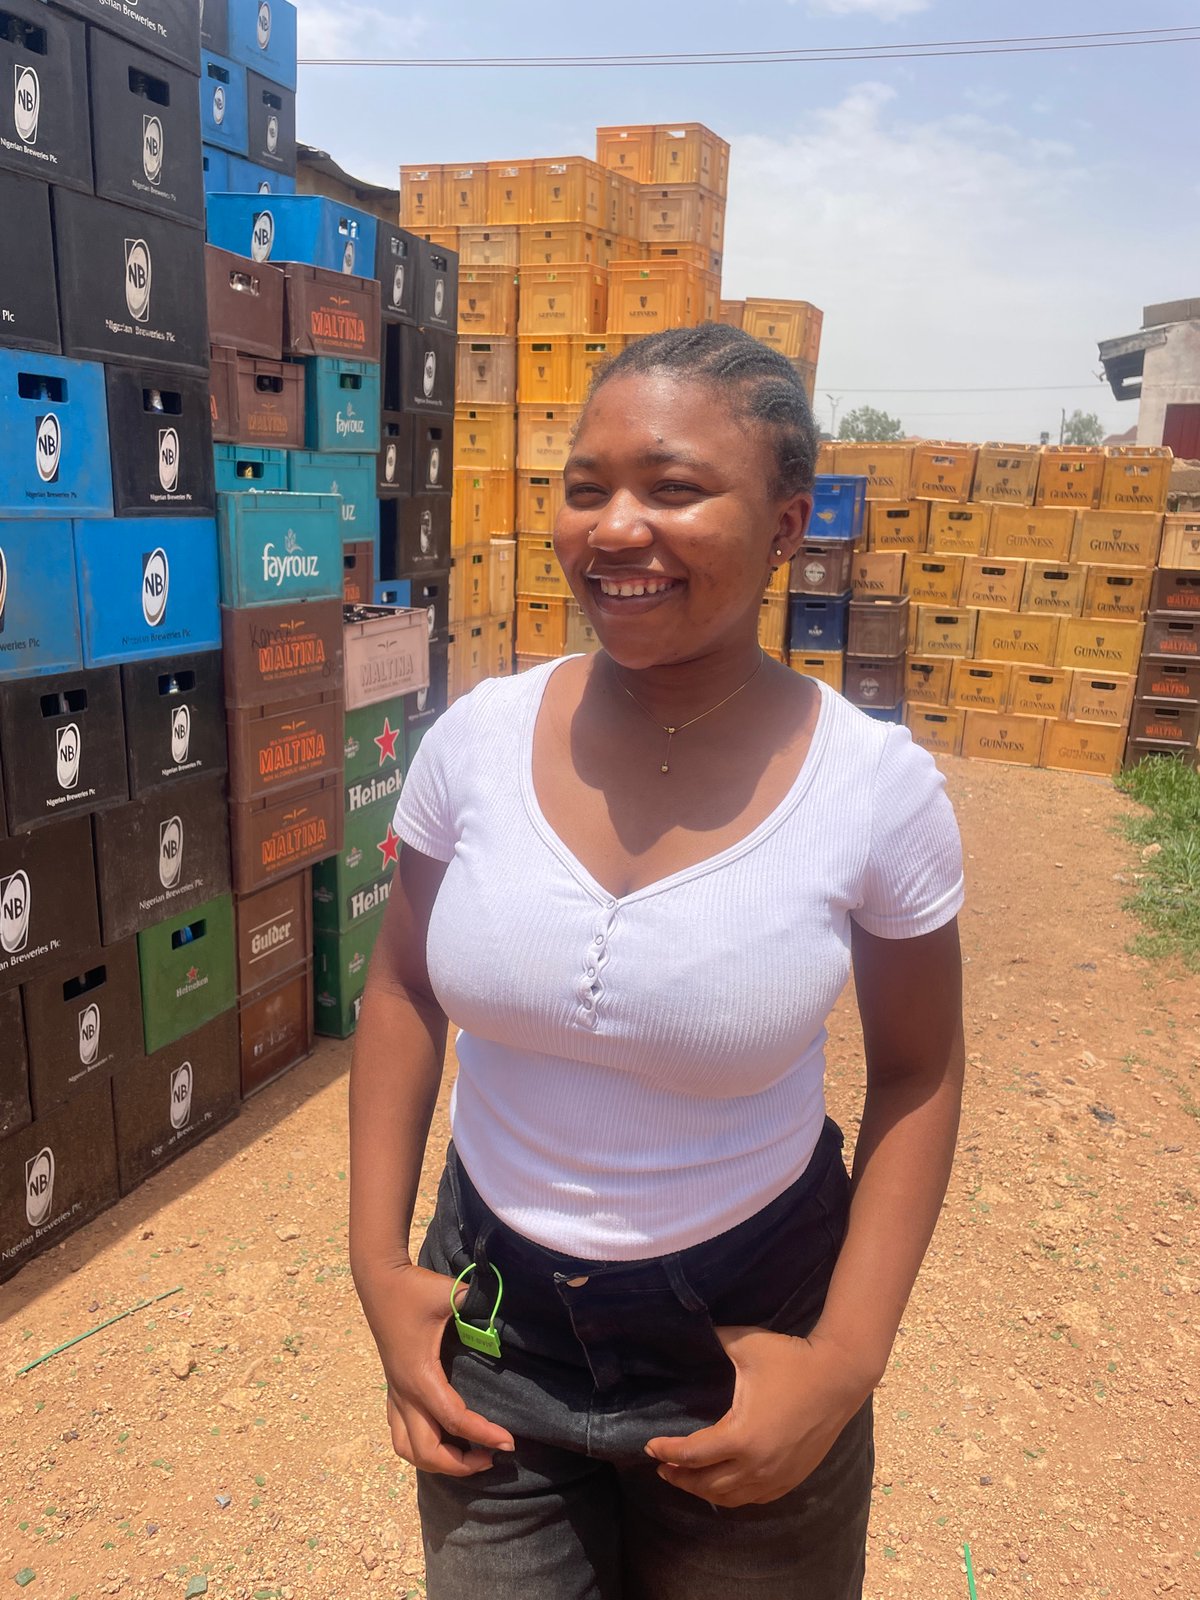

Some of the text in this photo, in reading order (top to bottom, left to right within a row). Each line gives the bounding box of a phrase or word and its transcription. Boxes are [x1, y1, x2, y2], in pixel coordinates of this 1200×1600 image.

[99, 0, 167, 37] erian Breweries Plc
[18, 89, 33, 112] NB
[0, 138, 58, 163] Nigerian Breweries Plc
[146, 136, 158, 156] NB
[255, 231, 268, 245] NB
[128, 262, 146, 289] NB
[2, 309, 15, 322] Plc
[105, 319, 176, 342] Nigerian Breweries Plc
[311, 311, 365, 343] MALTINA
[336, 411, 364, 437] fayrouz
[38, 434, 56, 456] NB
[162, 450, 175, 465] NB
[866, 476, 893, 487] NNESS
[922, 481, 957, 493] GUINNESS
[985, 485, 1022, 497] GUINNESS
[1050, 489, 1087, 500] GUINNESS
[1114, 493, 1153, 504] GUINNESS
[881, 536, 915, 544] GUINNESS
[1006, 534, 1054, 547] GUINNESS
[1090, 539, 1140, 553] GUINNESS
[262, 542, 320, 586] fayrouz
[145, 573, 163, 596] NB
[853, 578, 885, 591] INNESS
[913, 587, 948, 598] GUINNESS
[972, 592, 1007, 603] GUINNESS
[1034, 596, 1070, 607] GUINNESS
[1097, 602, 1135, 613] GUINNESS
[0, 637, 40, 652] weries Plc
[150, 631, 181, 642] Breweries
[927, 639, 961, 649] GUINNESS
[259, 639, 325, 673] MALTINA
[1074, 646, 1122, 659] GUINNESS
[361, 654, 414, 687] MALTINA
[960, 693, 995, 704] GUINNESS
[1019, 699, 1056, 711] GUINNESS
[1081, 706, 1118, 718] GUINNESS
[174, 724, 186, 740] NB
[979, 737, 1025, 751] GUINNESS
[60, 745, 75, 762] NB
[259, 733, 326, 775] MALTINA
[46, 796, 66, 807] Nigerian
[67, 790, 89, 801] Breweries
[349, 769, 402, 811] Heinek
[162, 840, 178, 860] NB
[262, 818, 327, 865] MALTINA
[138, 879, 203, 910] Nigerian Breweries Plc
[352, 876, 393, 919] Hein
[3, 897, 23, 920] NB
[251, 921, 291, 954] Gulder
[10, 944, 49, 966] Breweries
[50, 939, 62, 950] Plc
[176, 975, 209, 998] Heineken
[82, 1024, 95, 1041] NB
[174, 1084, 188, 1103] NB
[204, 1111, 212, 1121] Plc
[30, 1174, 48, 1196] NB
[1, 1202, 82, 1260] Nigerian Breweries Plc
